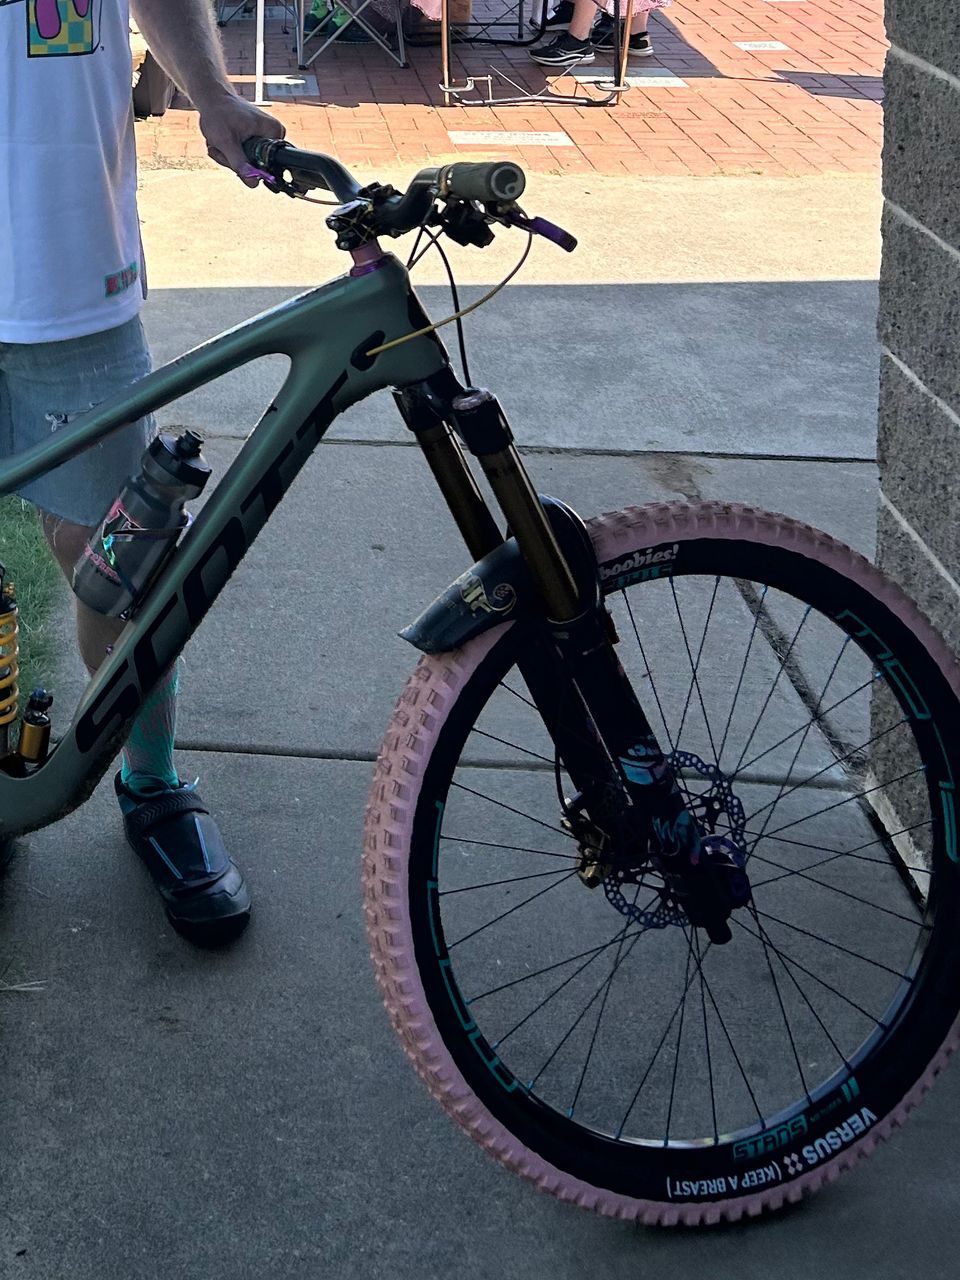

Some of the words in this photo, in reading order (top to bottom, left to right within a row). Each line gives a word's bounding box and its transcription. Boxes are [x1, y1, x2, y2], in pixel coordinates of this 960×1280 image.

[75, 369, 348, 754] SCOTT
[801, 1106, 879, 1165] VERSUS
[666, 1175, 727, 1198] BREAST)
[727, 1175, 739, 1190] A
[741, 1160, 782, 1189] (KEEP
